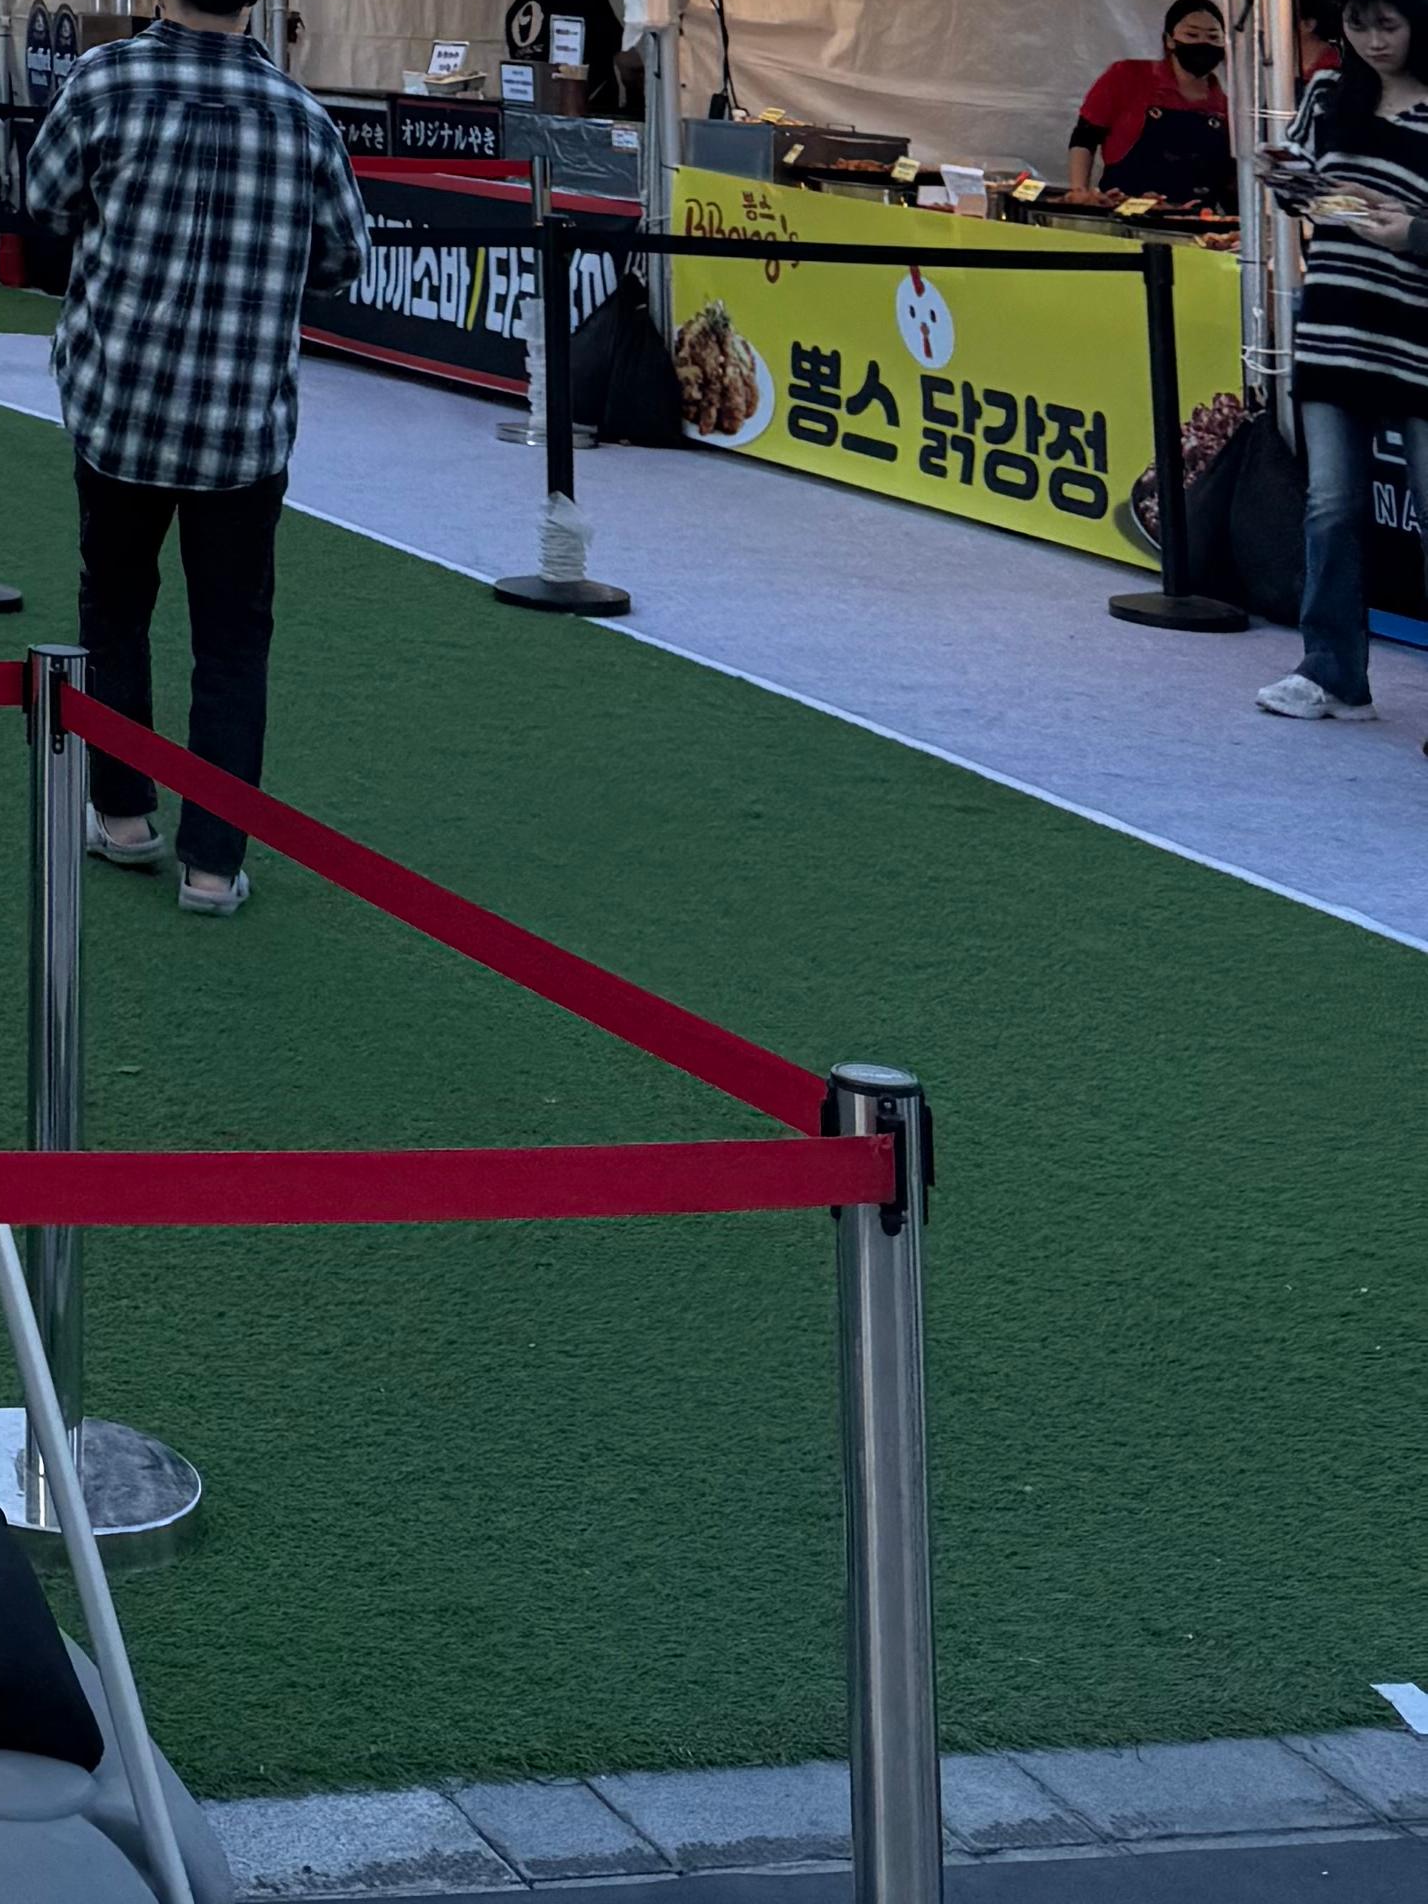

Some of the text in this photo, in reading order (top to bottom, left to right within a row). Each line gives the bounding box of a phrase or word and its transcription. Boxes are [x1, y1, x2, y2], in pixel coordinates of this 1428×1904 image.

[401, 118, 496, 156] オリジナルやき
[788, 341, 1110, 520] 뽕스 닭강정
